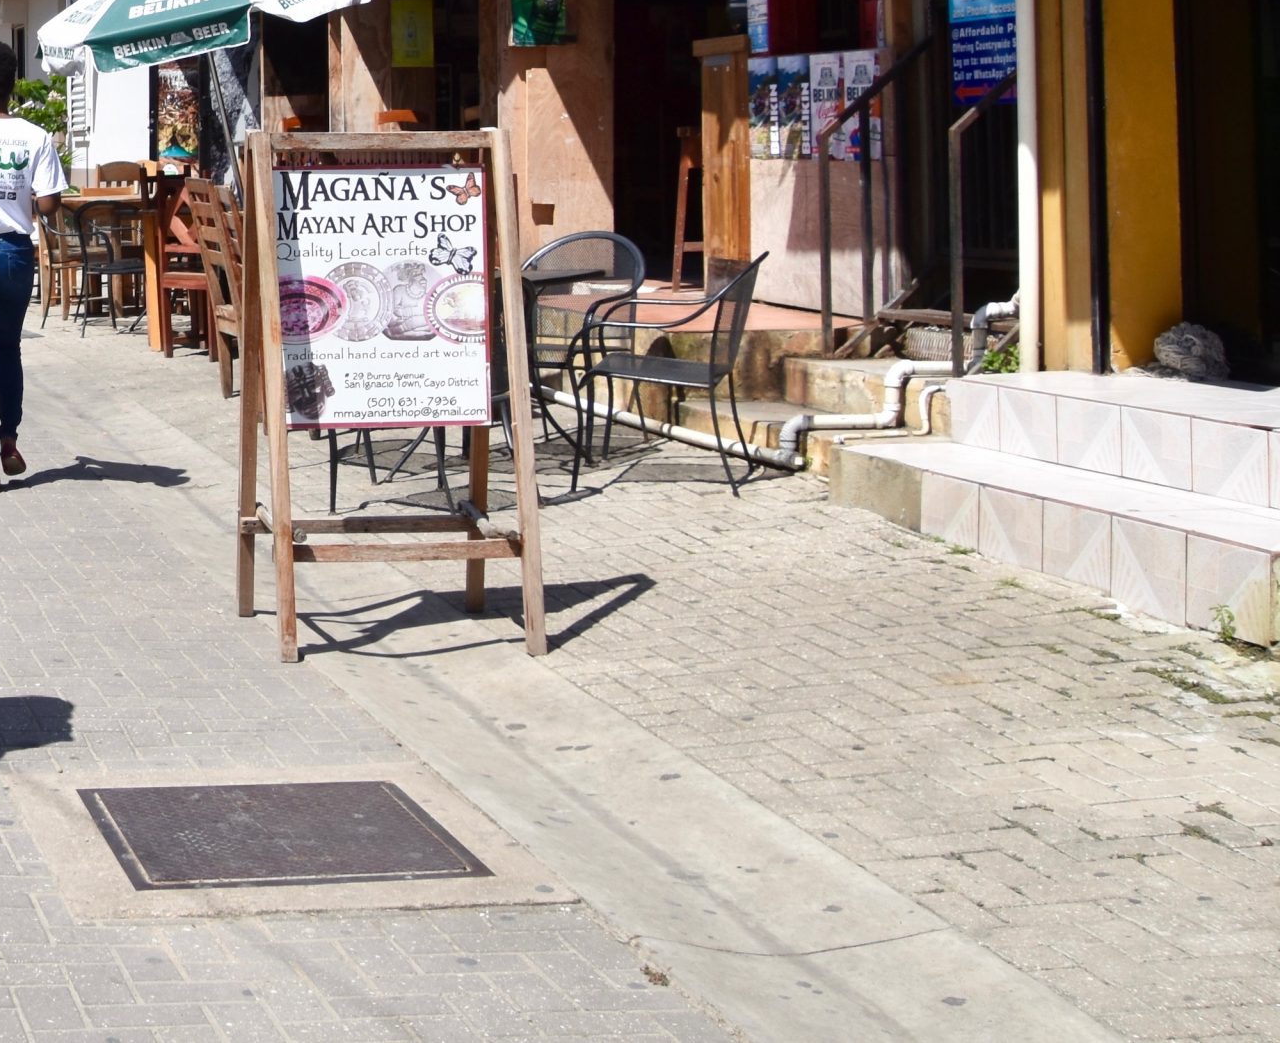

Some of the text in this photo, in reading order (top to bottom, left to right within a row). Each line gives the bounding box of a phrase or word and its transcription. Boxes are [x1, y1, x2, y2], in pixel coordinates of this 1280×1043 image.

[952, 25, 1004, 40] @Affordable
[112, 22, 230, 60] BELIKIN BEER
[966, 70, 973, 81] or
[7, 172, 25, 180] Tours
[280, 170, 448, 211] MAGAÑA'S
[277, 210, 477, 241] MAYAN ART SHOP
[276, 240, 428, 263] Quality Local crafts
[281, 346, 478, 361] Traditional hand carved art works
[352, 372, 364, 380] 29
[393, 371, 426, 380] Avenue
[344, 377, 479, 391] San Ignacio Town, Cayo District
[366, 396, 395, 409] (501)
[397, 395, 418, 406] 631
[426, 395, 457, 407] 7936
[333, 405, 486, 420] mmayanartshop@gmail.com
